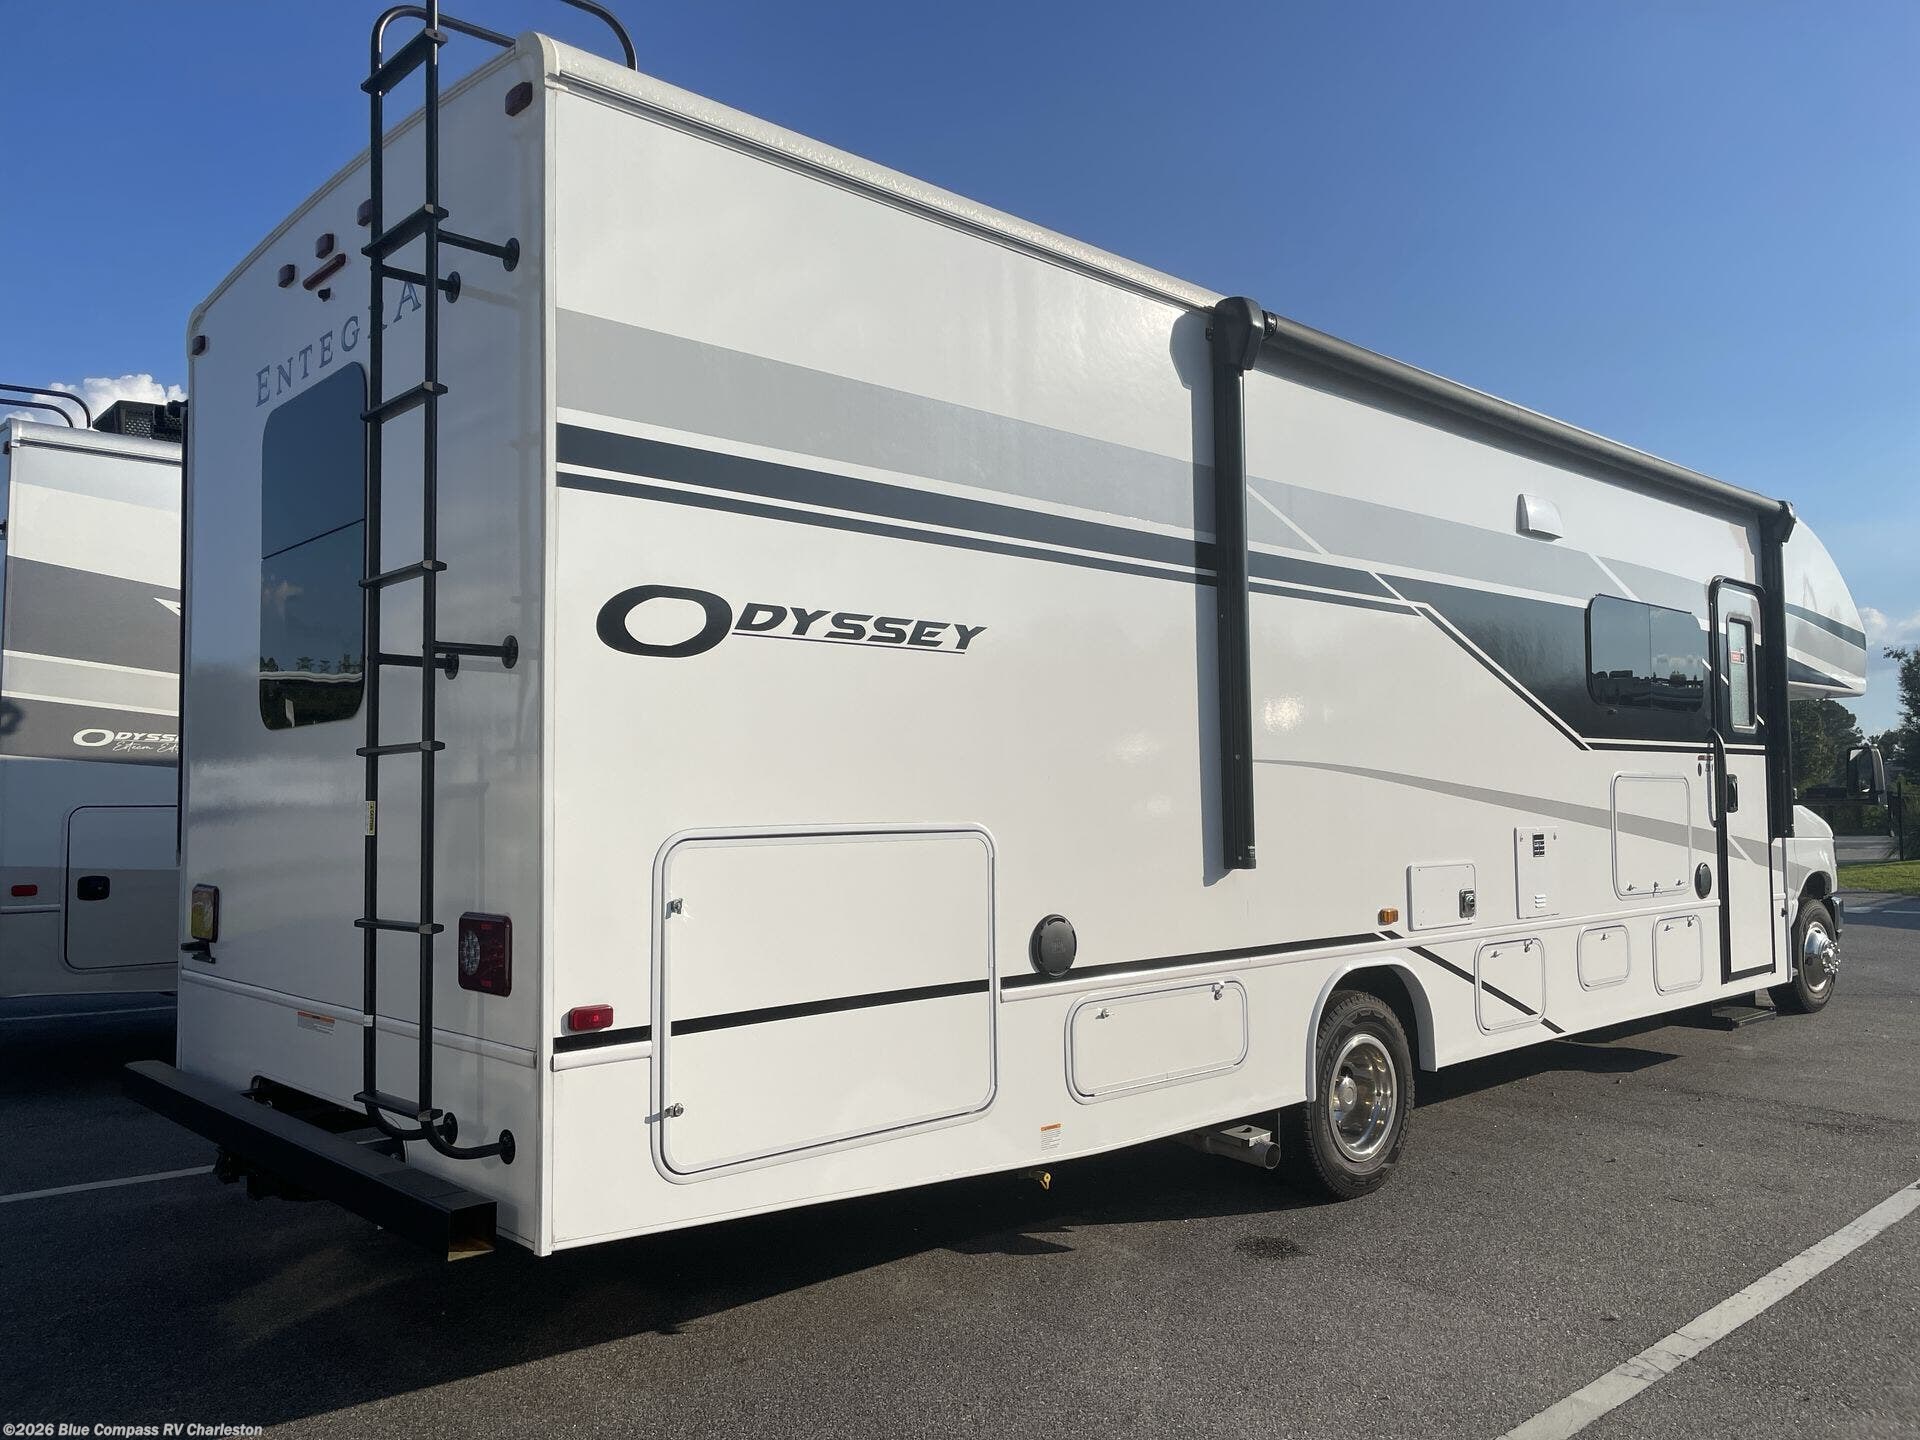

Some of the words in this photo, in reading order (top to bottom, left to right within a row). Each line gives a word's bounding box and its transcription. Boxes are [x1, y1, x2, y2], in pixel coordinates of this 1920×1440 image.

[255, 281, 422, 408] ENTEGA
[596, 584, 988, 658] ODYSSEY
[73, 729, 179, 747] ODYSS
